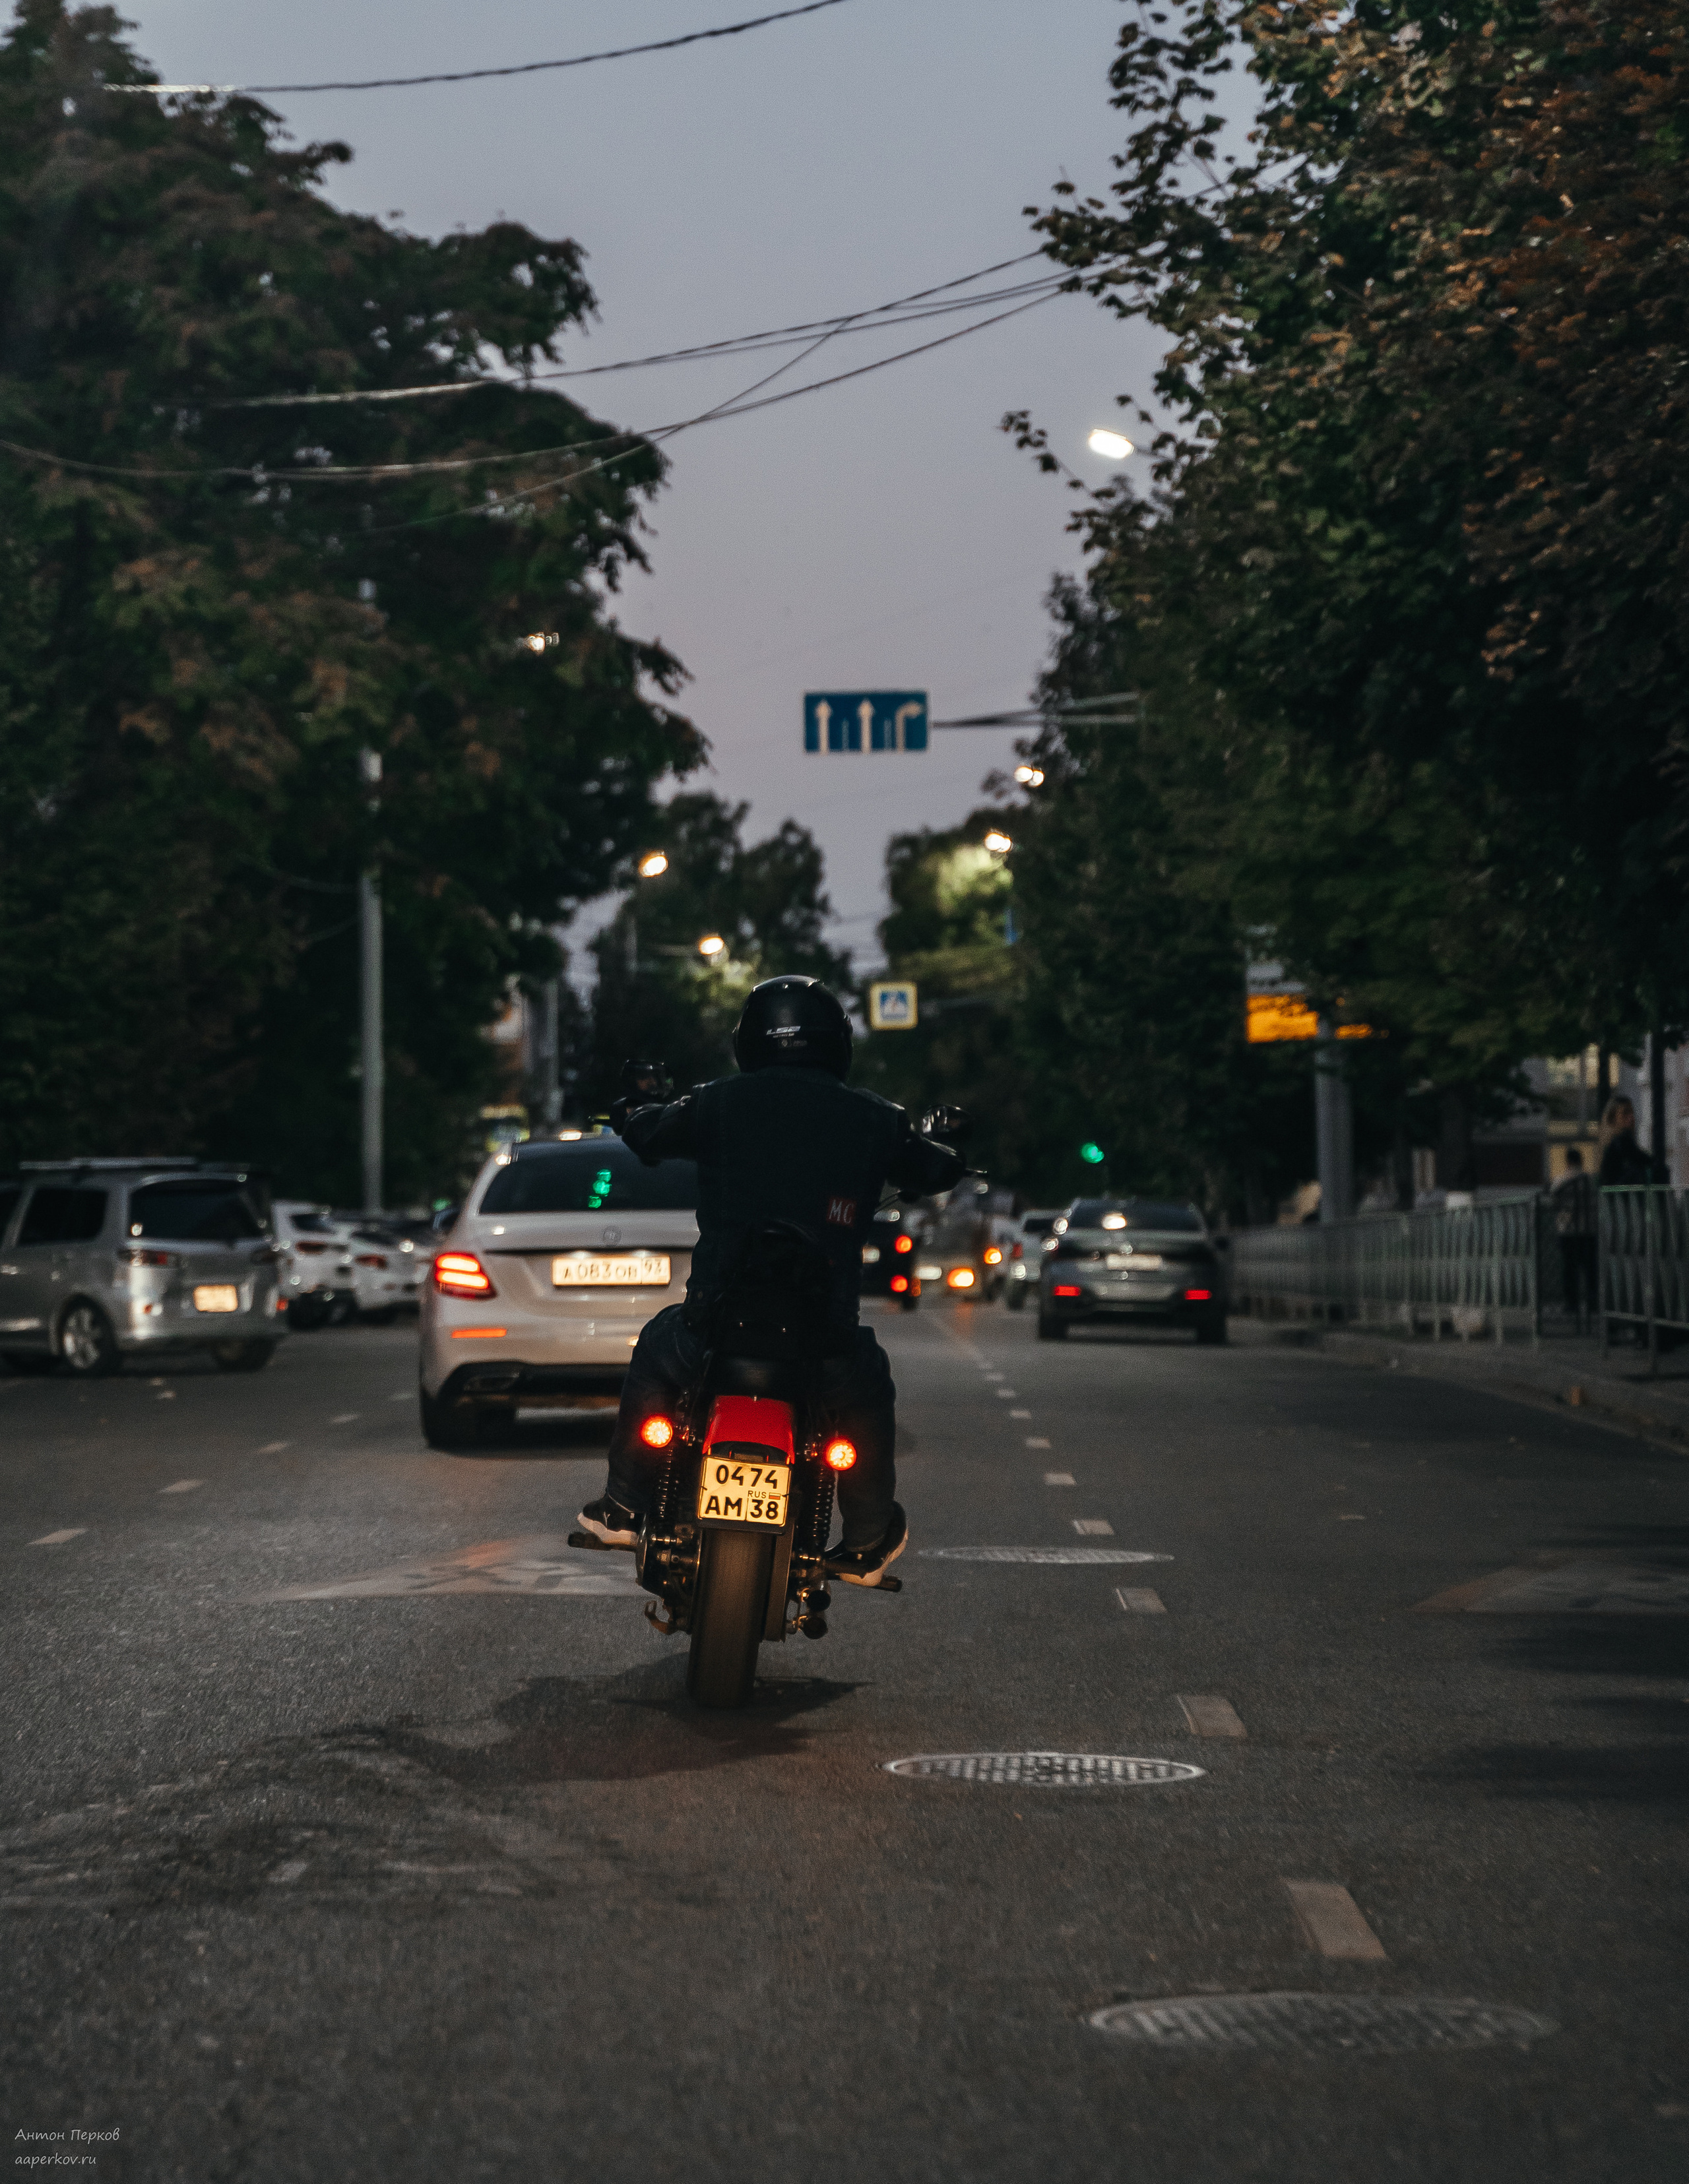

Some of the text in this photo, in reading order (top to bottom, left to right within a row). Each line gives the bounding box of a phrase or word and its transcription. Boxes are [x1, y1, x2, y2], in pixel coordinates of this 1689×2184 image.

[829, 1199, 854, 1224] MC
[716, 1464, 778, 1489] 0474
[748, 1490, 767, 1499] RUS
[749, 1499, 779, 1520] 38
